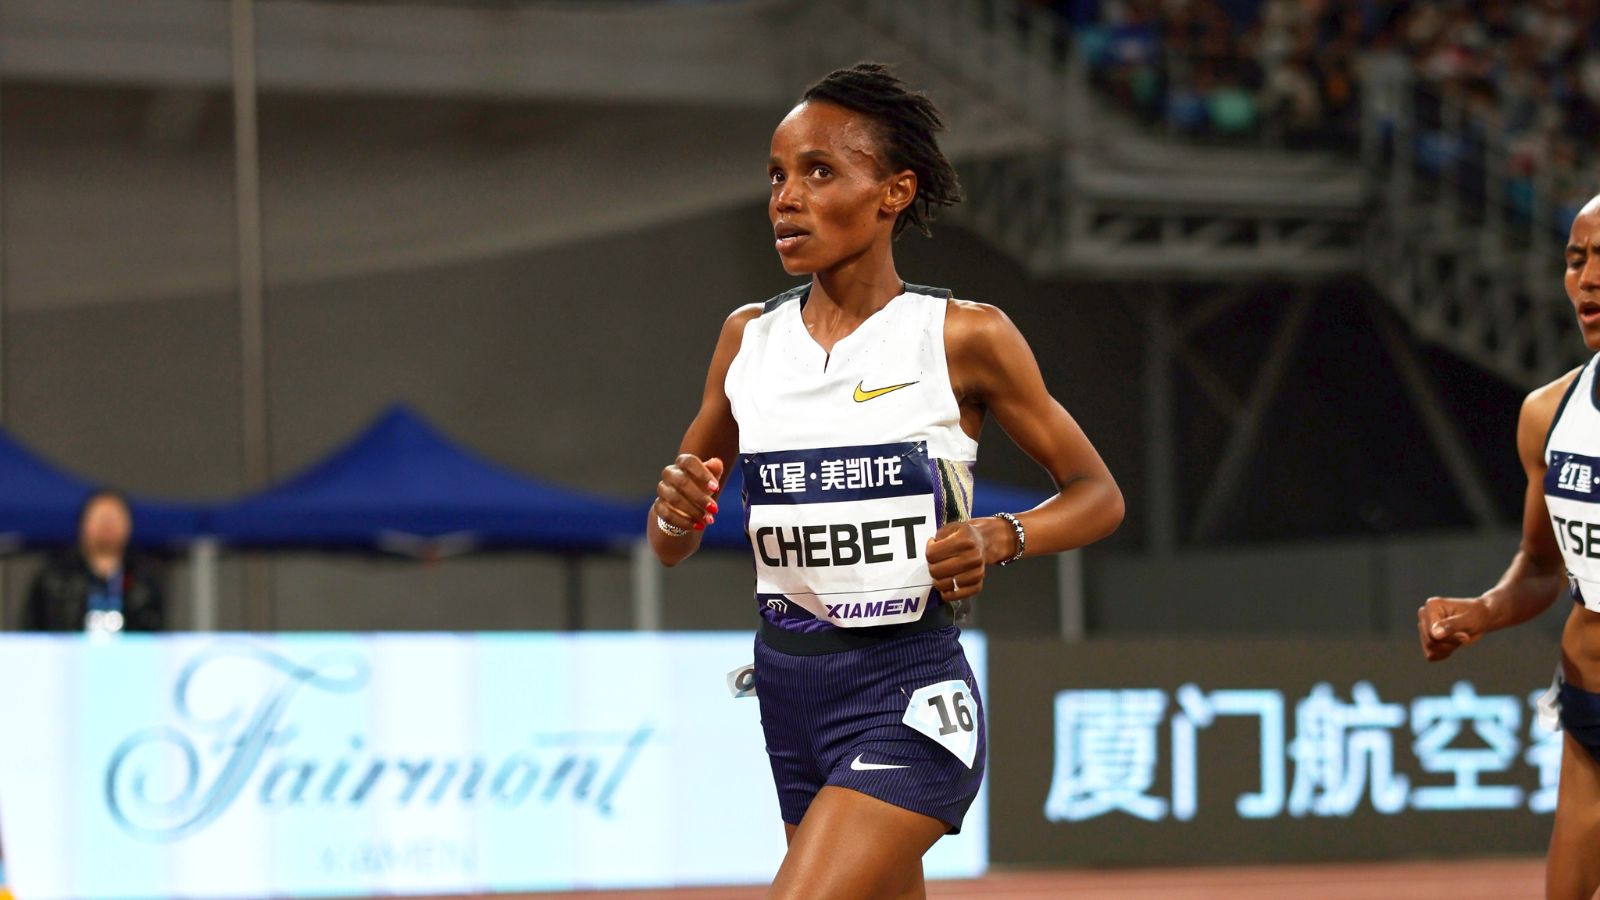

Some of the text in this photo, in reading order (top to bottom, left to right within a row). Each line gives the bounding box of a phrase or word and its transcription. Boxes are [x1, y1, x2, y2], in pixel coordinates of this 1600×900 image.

[756, 515, 927, 568] CHEBET
[825, 597, 921, 619] XIAMEN
[928, 691, 974, 737] 16
[103, 641, 660, 845] Fairmont
